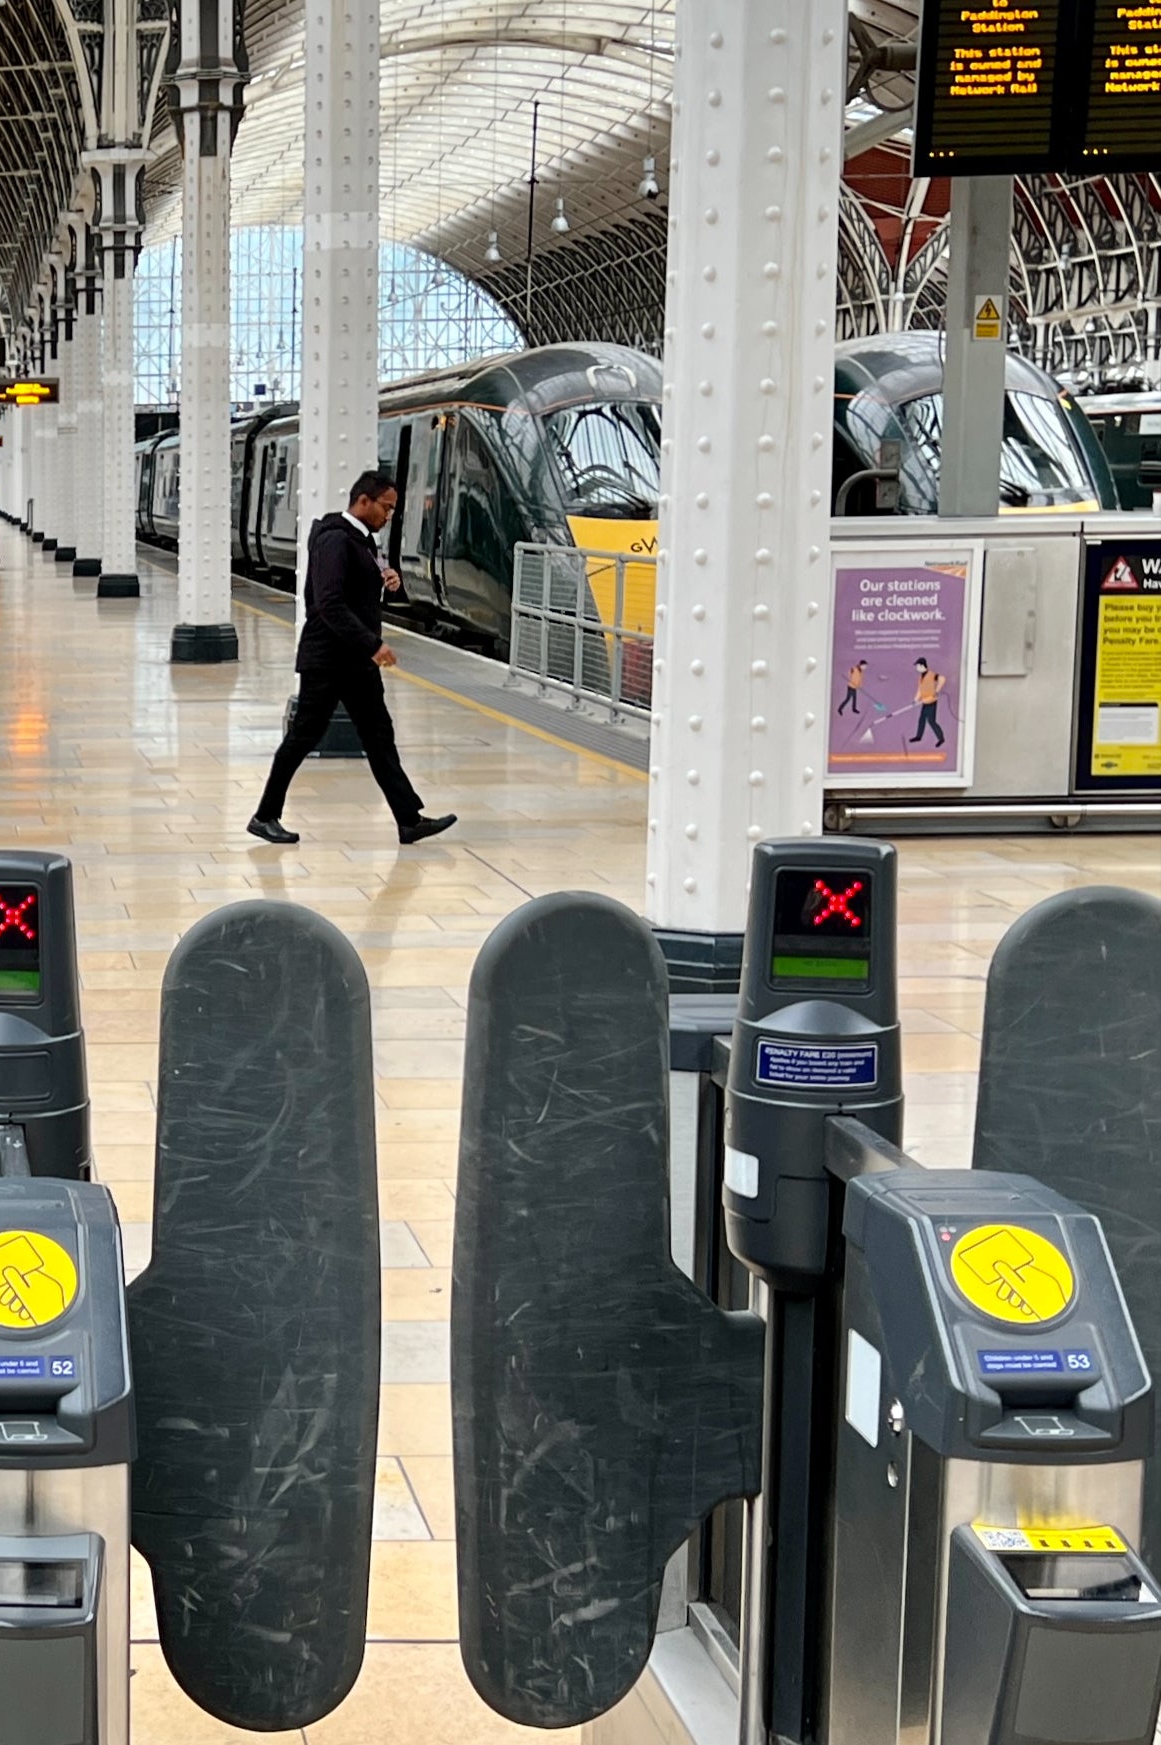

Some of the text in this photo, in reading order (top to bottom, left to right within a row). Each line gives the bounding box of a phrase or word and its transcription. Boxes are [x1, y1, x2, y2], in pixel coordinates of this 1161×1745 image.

[961, 9, 1038, 21] Paddington
[972, 22, 1025, 33] Station
[954, 46, 1040, 58] This station
[1110, 45, 1138, 55] This
[950, 58, 1042, 71] is owned and
[1105, 58, 1119, 68] is
[955, 70, 1035, 83] managed by
[950, 82, 1038, 95] Network Rail
[1105, 81, 1160, 93] Network
[860, 579, 941, 592] Our stations
[860, 594, 938, 607] are cleaned
[851, 608, 946, 622] like clockwork.
[1104, 603, 1135, 613] Please
[1137, 603, 1154, 615] buy
[1104, 615, 1132, 624] before
[1135, 617, 1152, 625] you
[1103, 628, 1120, 636] you
[1123, 628, 1141, 636] may
[1144, 626, 1155, 634] be
[1103, 638, 1136, 647] Penalty
[52, 1360, 73, 1375] 52
[1067, 1354, 1091, 1369] 53
